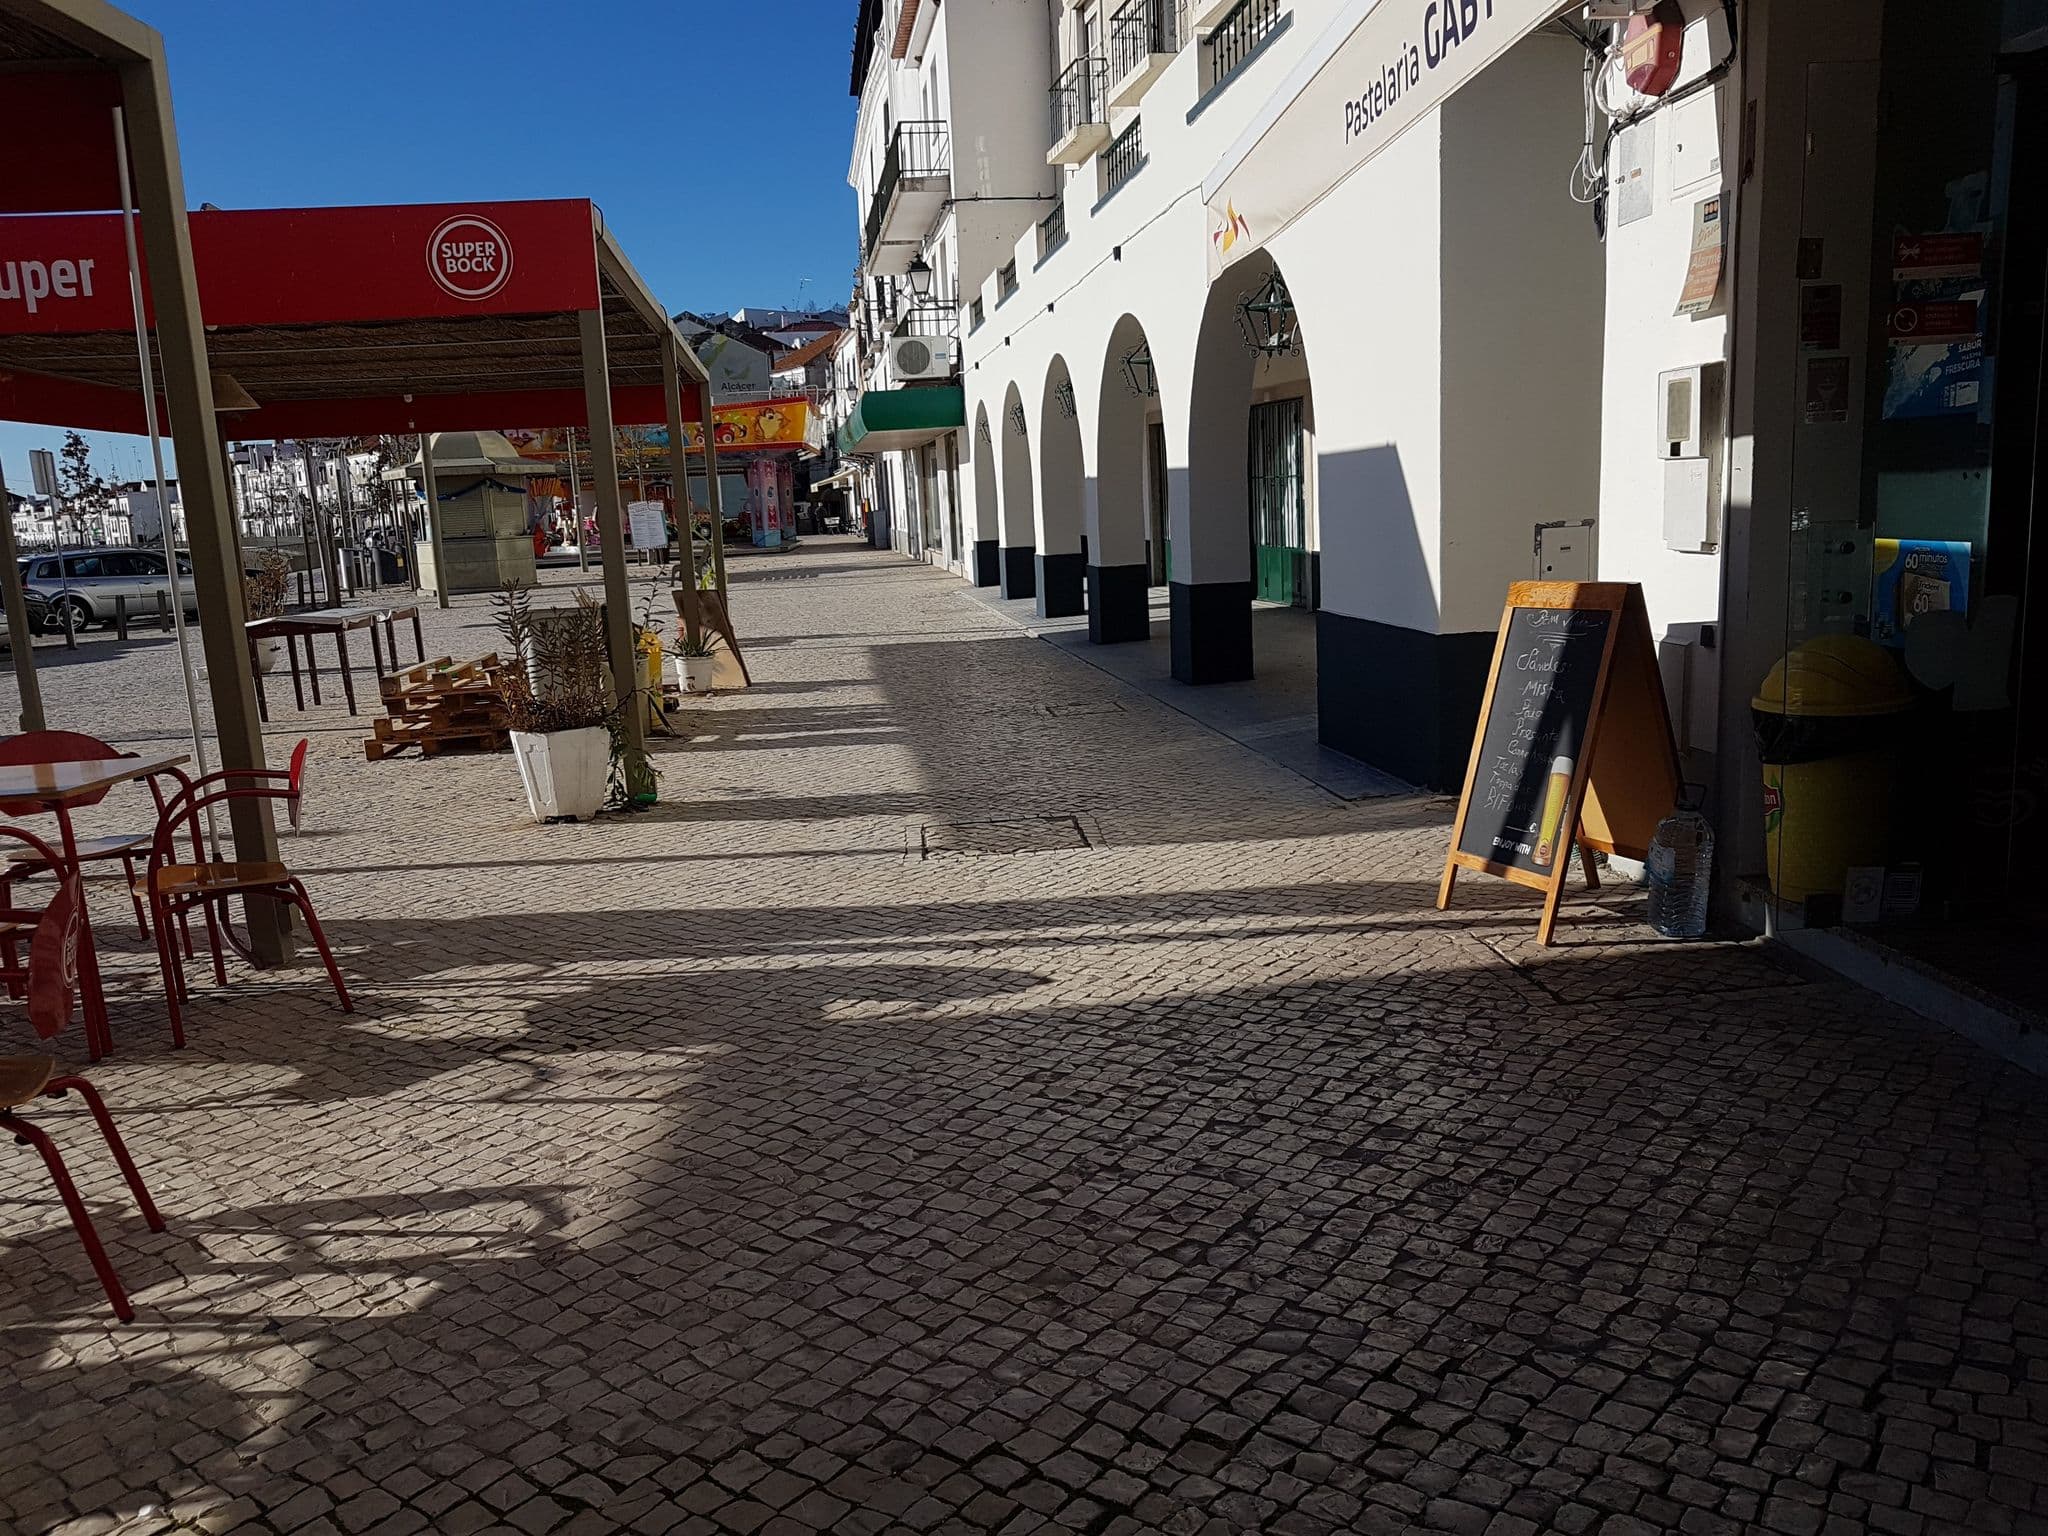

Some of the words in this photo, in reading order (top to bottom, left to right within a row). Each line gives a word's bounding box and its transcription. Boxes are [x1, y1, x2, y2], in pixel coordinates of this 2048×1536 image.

[1344, 42, 1420, 145] Pastelaria
[441, 241, 496, 258] SUPER
[445, 256, 496, 273] BOCK
[1905, 553, 1919, 569] 60
[1913, 593, 1929, 613] 60
